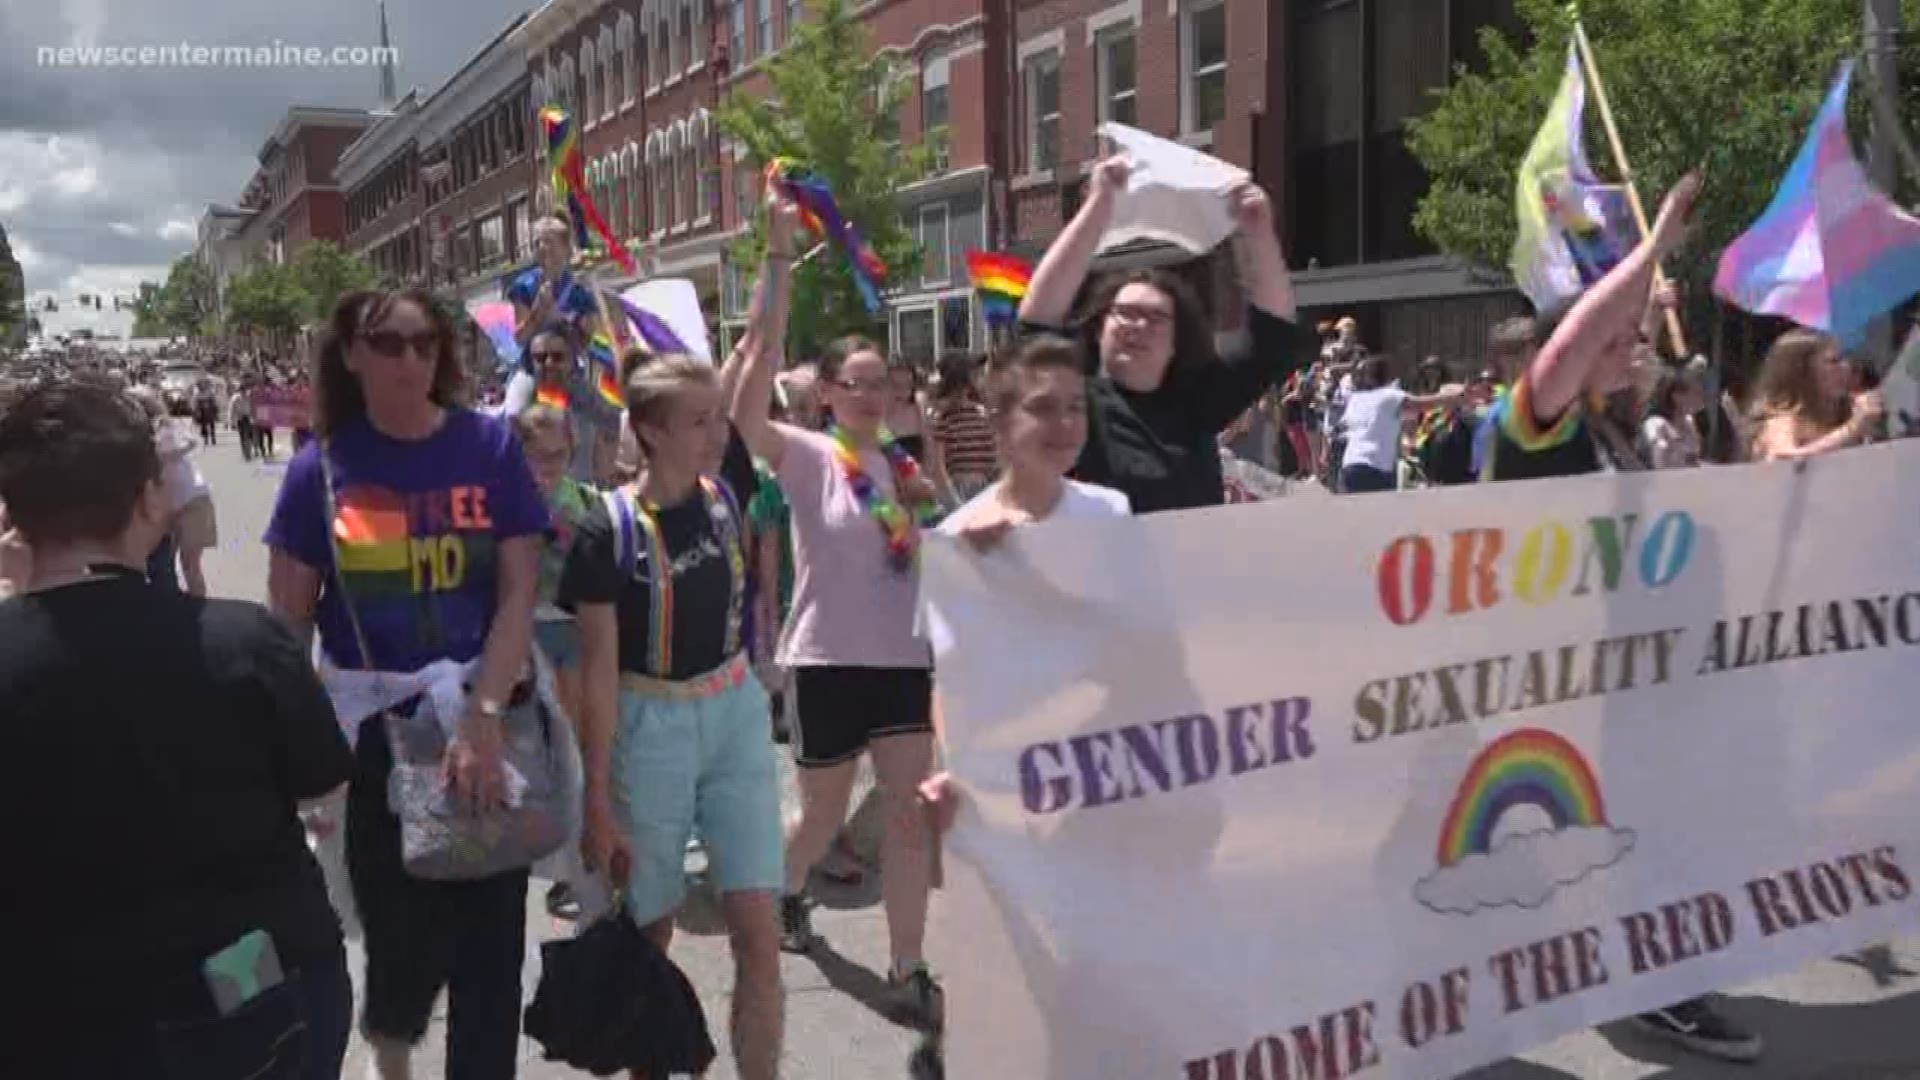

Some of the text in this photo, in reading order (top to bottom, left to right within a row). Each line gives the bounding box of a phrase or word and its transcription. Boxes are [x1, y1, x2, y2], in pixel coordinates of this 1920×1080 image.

[1378, 510, 1696, 626] ORONO
[1018, 592, 1920, 815] GENDER SEXUALITY ALLIANC
[1400, 966, 1470, 1050] OF
[1488, 926, 1608, 1013] THE
[1619, 891, 1735, 975] RED
[1744, 845, 1912, 937] RIOTS
